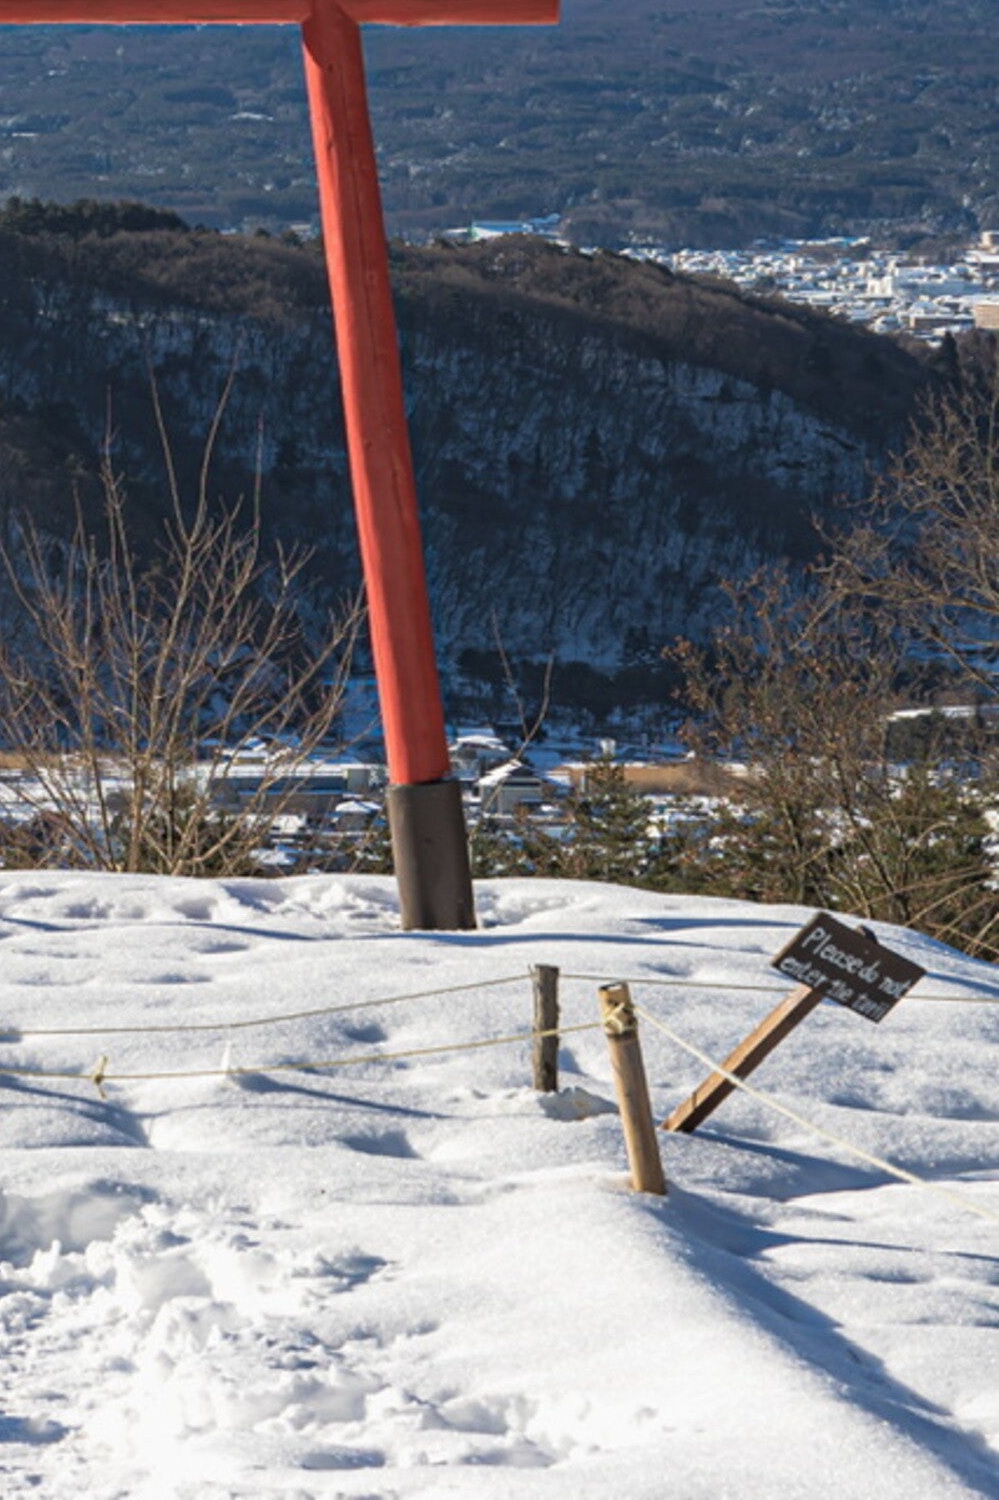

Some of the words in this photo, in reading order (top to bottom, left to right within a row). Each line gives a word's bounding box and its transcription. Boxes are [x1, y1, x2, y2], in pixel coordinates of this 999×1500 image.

[780, 956, 827, 987] enter
[827, 978, 854, 1002] the
[802, 927, 863, 974] Please
[858, 961, 880, 984] do
[878, 976, 911, 999] not
